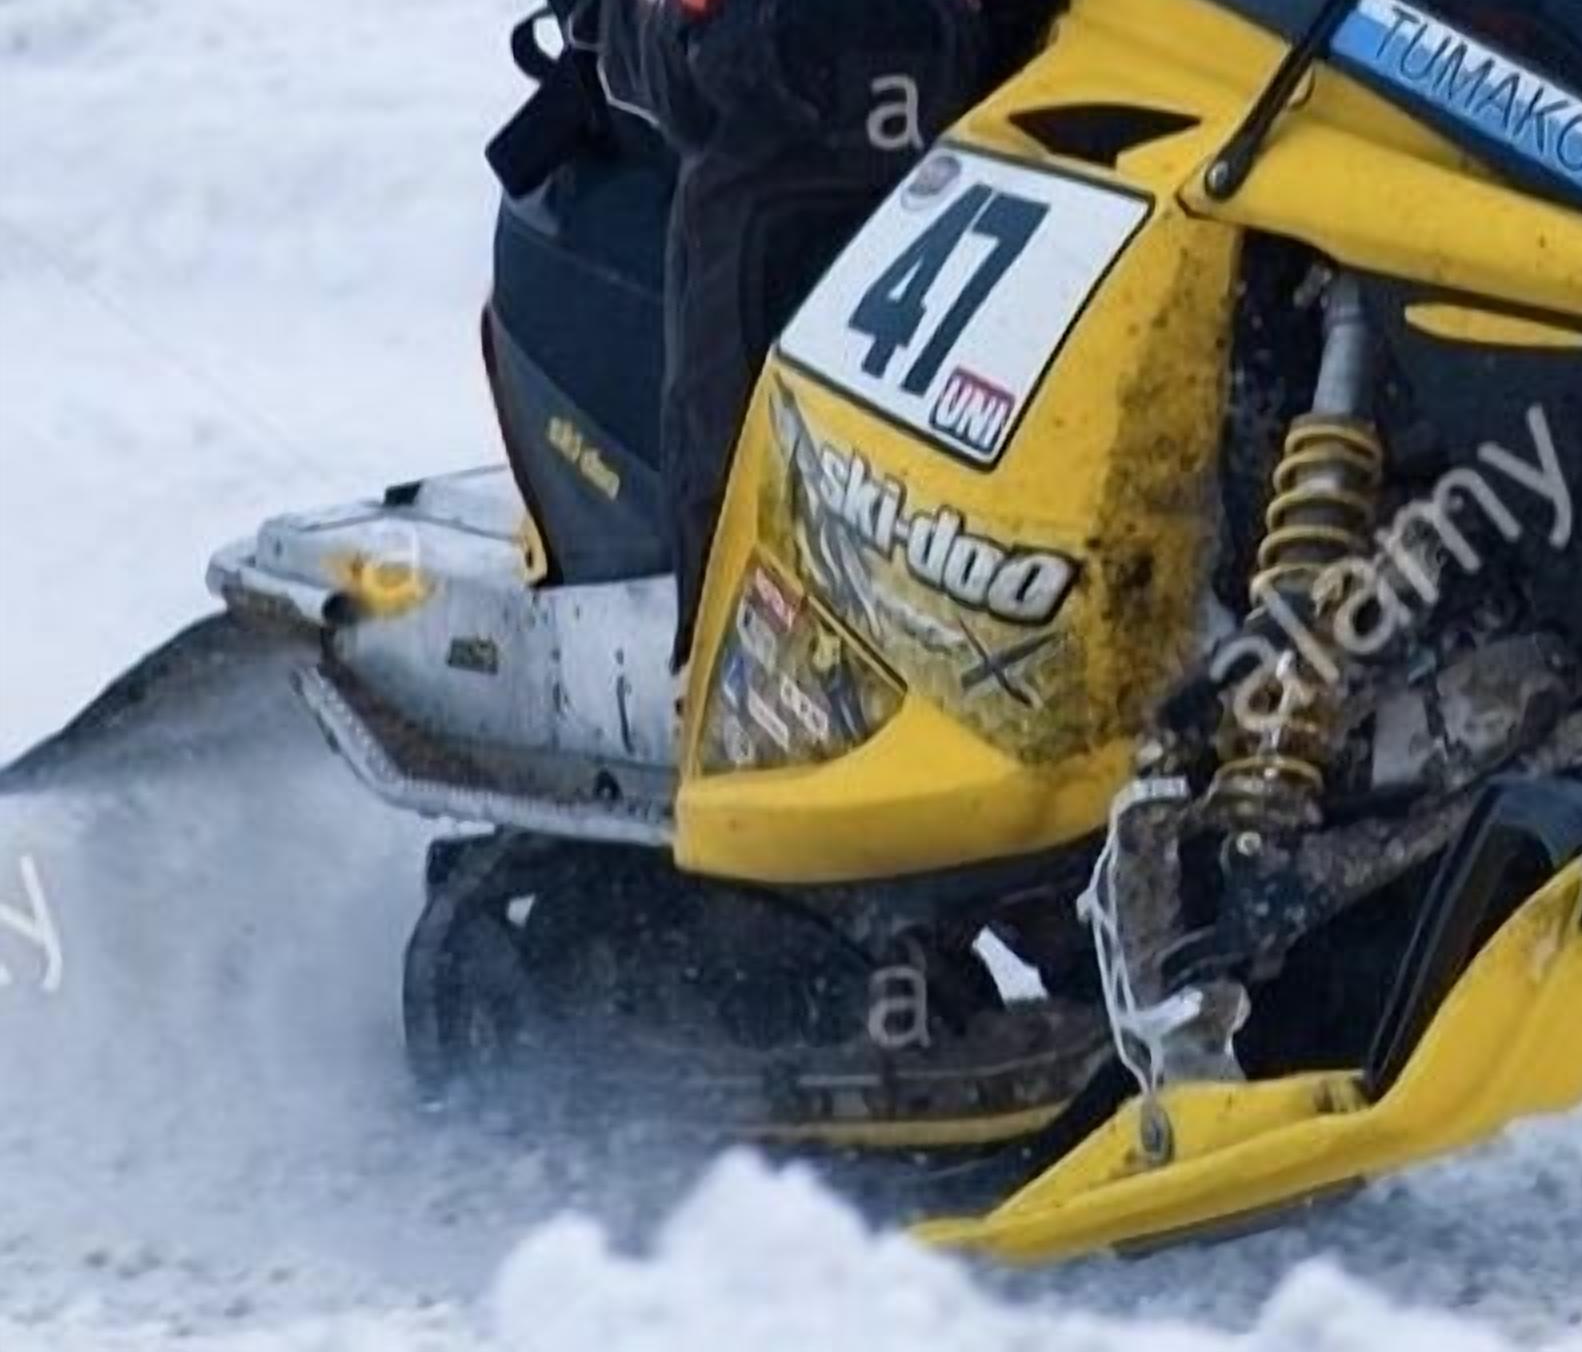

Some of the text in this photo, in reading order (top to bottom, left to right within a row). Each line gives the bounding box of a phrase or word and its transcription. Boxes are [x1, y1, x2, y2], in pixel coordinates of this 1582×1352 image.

[848, 182, 1051, 398] 47
[933, 373, 1010, 451] UNI
[818, 445, 1078, 624] ski-doo
